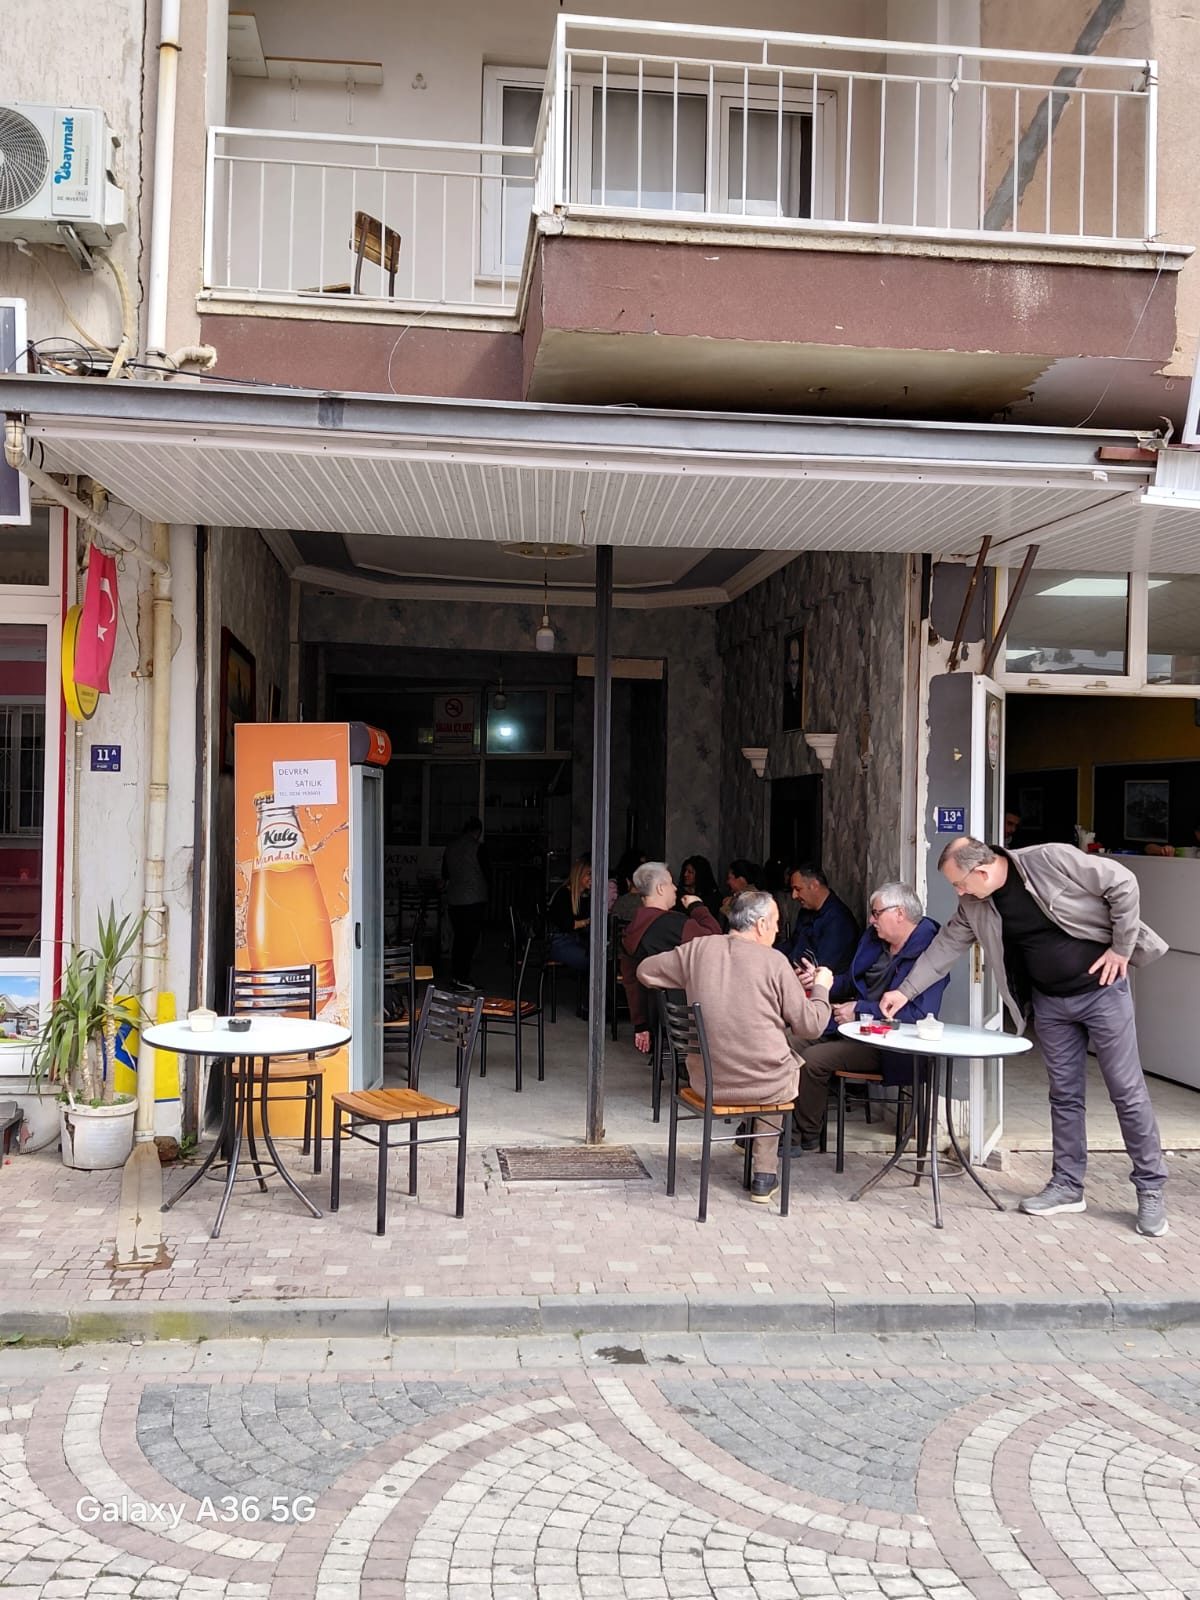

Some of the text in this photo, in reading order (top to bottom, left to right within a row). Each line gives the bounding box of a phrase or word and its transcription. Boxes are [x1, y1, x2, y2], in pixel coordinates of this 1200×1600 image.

[60, 116, 75, 169] baymak
[97, 749, 110, 761] 11
[278, 768, 309, 776] DEVREN
[263, 828, 298, 846] Kula
